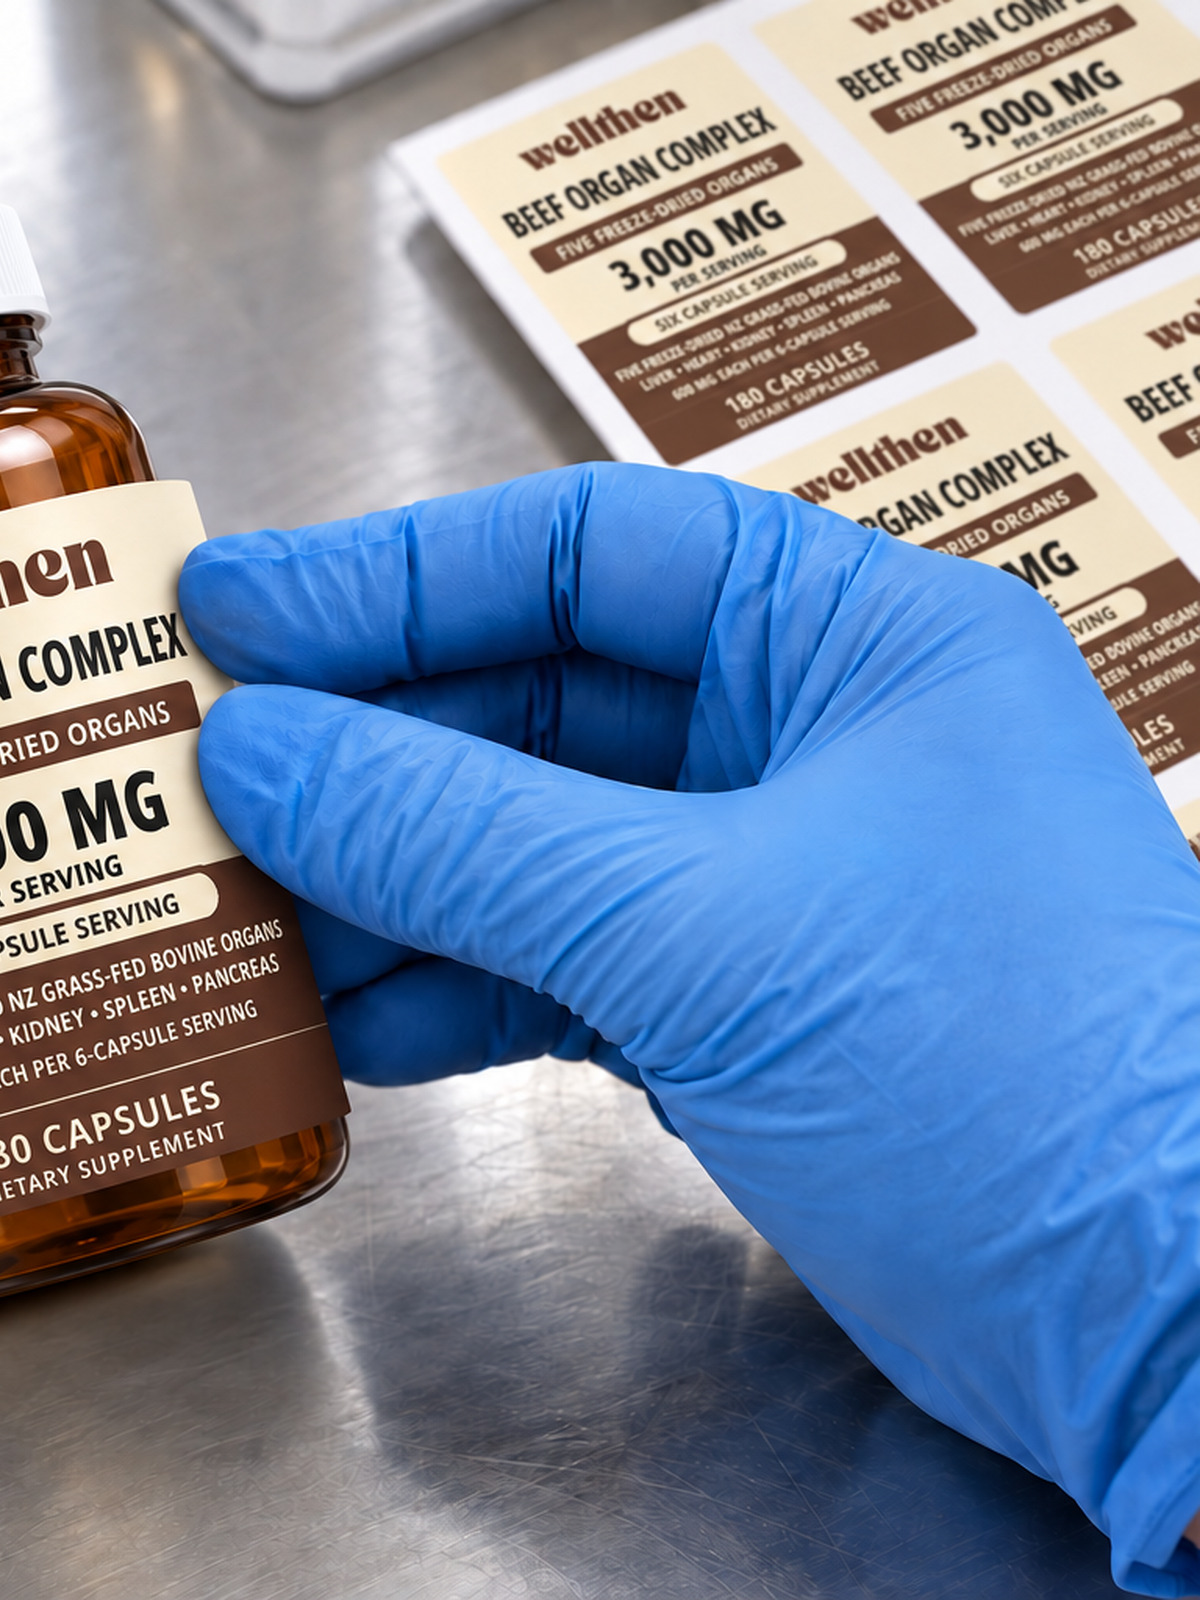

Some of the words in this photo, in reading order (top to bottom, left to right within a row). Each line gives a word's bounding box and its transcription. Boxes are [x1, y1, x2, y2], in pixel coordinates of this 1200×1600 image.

[837, 57, 902, 101] BEEF
[902, 17, 1002, 74] ORGAN
[896, 97, 934, 120] FIVE
[934, 51, 1041, 103] FREEZE-DRIED
[1043, 20, 1111, 56] ORGANS
[520, 91, 686, 172] wellthen
[950, 90, 1053, 149] 3,000
[1051, 61, 1122, 106] MG
[502, 194, 564, 238] BEEF
[565, 156, 660, 210] ORGAN
[656, 107, 776, 172] COMPLEX
[556, 235, 594, 259] FIVE
[594, 189, 705, 241] FREEZE-DRIED
[707, 158, 777, 194] ORGANS
[609, 229, 719, 291] 3,000
[714, 200, 786, 246] MG
[1074, 238, 1114, 267] 180
[726, 387, 764, 412] 180
[766, 342, 869, 395] CAPSULES
[1125, 374, 1192, 422] BEEF
[792, 418, 968, 508] wellthen
[939, 433, 1069, 508] COMPLEX
[992, 490, 1070, 534] ORGANS
[19, 612, 187, 692] COMPLEX
[68, 701, 170, 745] ORGANS
[62, 771, 169, 850] MG
[11, 855, 123, 903] SERVING
[75, 894, 179, 945] SERVING
[8, 987, 38, 1012] NZ
[42, 958, 145, 1002] GRASS-FED
[150, 937, 218, 972] BOVINE
[221, 919, 282, 952] ORGANS
[9, 1008, 83, 1045] KIDNEY
[103, 983, 176, 1019] SPLEEN
[192, 953, 279, 994] PANCREAS
[33, 1053, 71, 1078] PER
[75, 1022, 178, 1066] 6-CAPSULE
[182, 1000, 257, 1036] SERVING
[44, 1081, 224, 1155] CAPSULES
[78, 1122, 224, 1178] SUPPLEMENT
